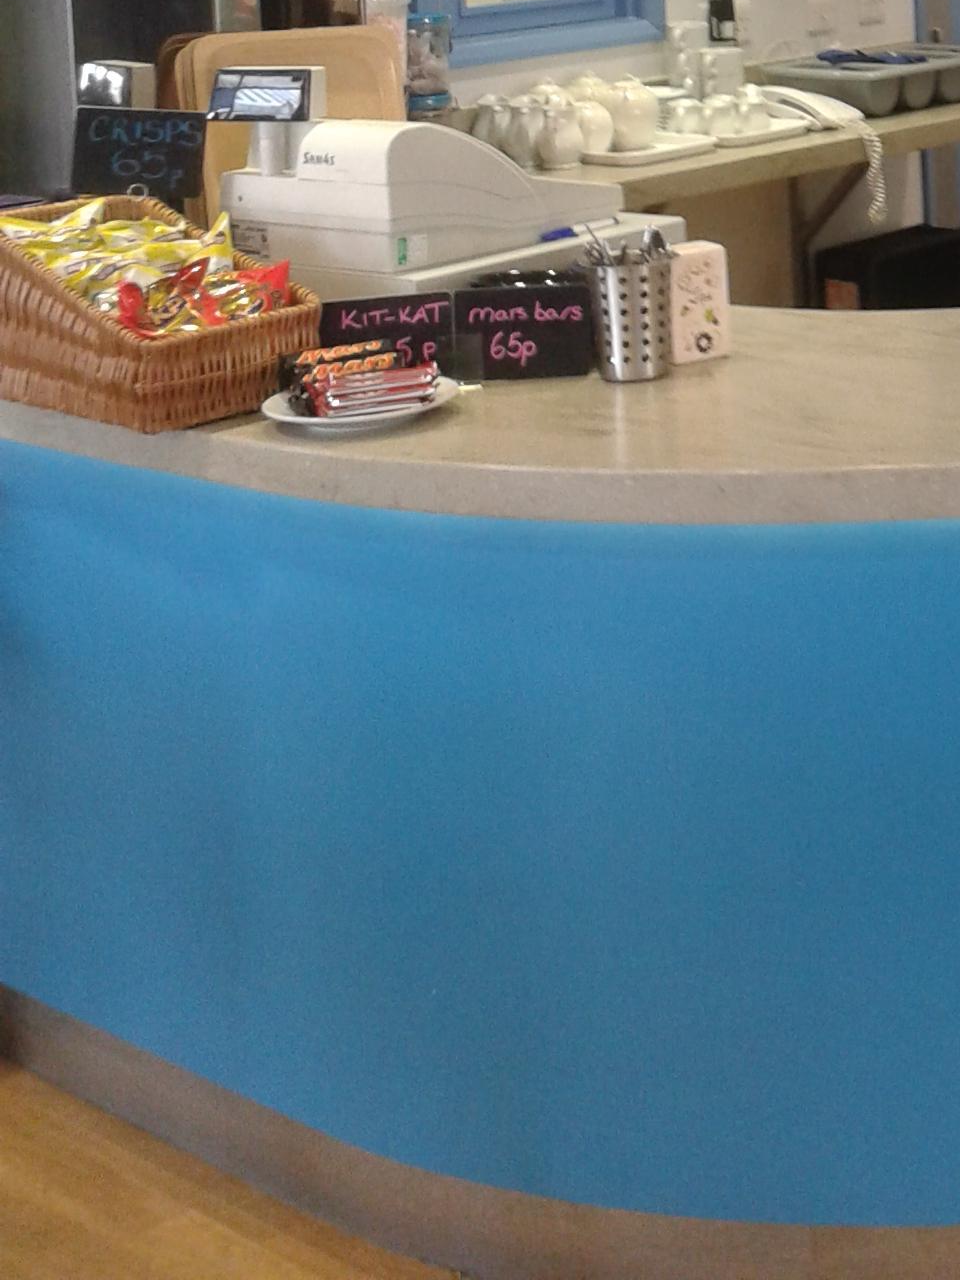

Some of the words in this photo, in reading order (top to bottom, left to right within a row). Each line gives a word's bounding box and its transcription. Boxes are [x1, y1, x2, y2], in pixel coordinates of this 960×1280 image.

[89, 115, 202, 147] CRISPS
[339, 301, 450, 330] KIT-KAT
[468, 304, 529, 324] mars
[533, 300, 584, 321] bars
[489, 331, 537, 367] 65p
